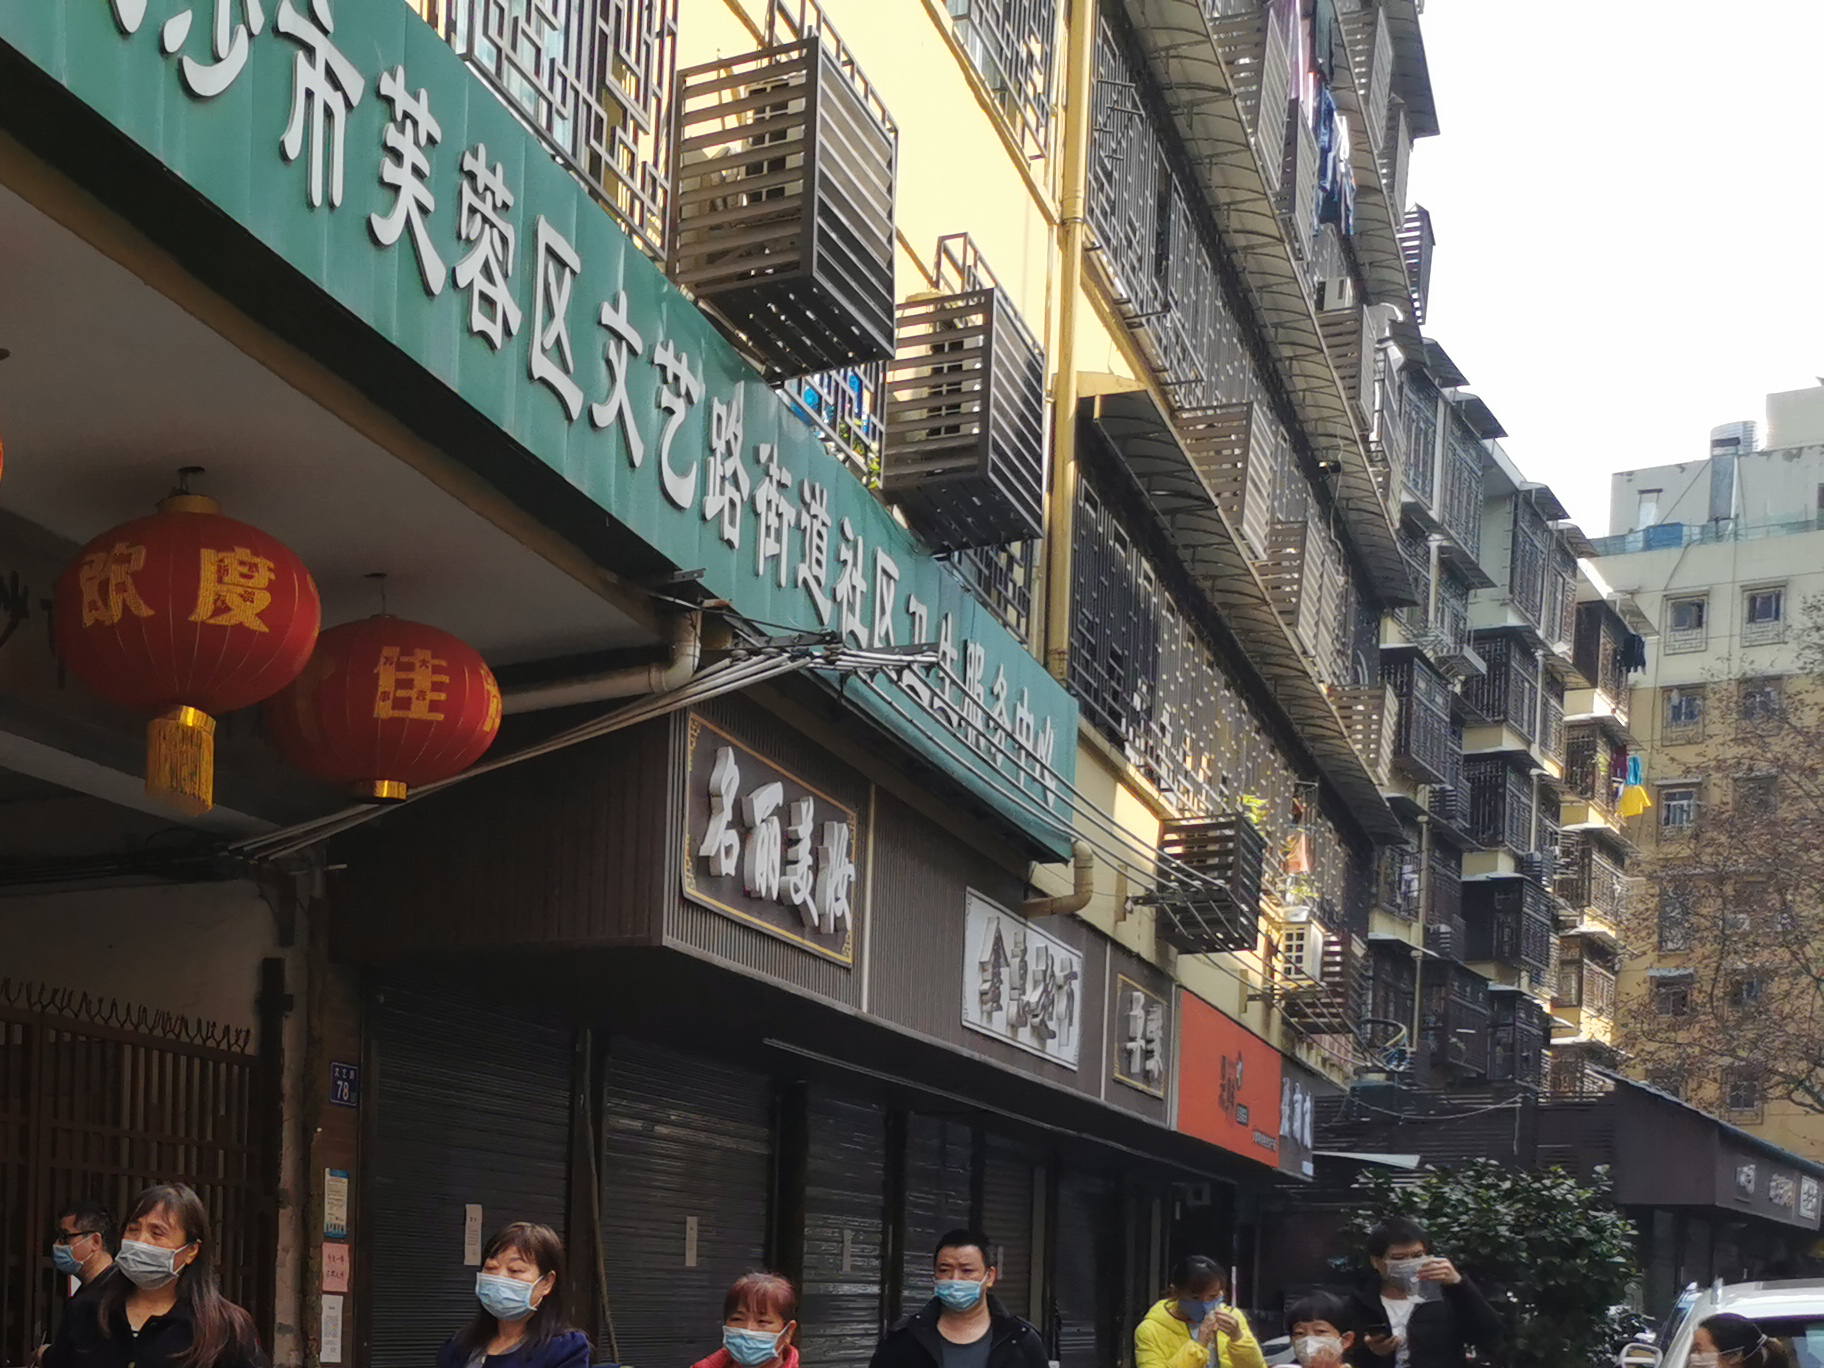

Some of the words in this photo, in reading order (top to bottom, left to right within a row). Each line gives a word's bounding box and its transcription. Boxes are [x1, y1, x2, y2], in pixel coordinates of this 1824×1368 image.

[110, 0, 1056, 808] 市芙蓉区文艺路街道社区卫生服务中心
[373, 646, 451, 721] 佳
[336, 1080, 350, 1101] 78
